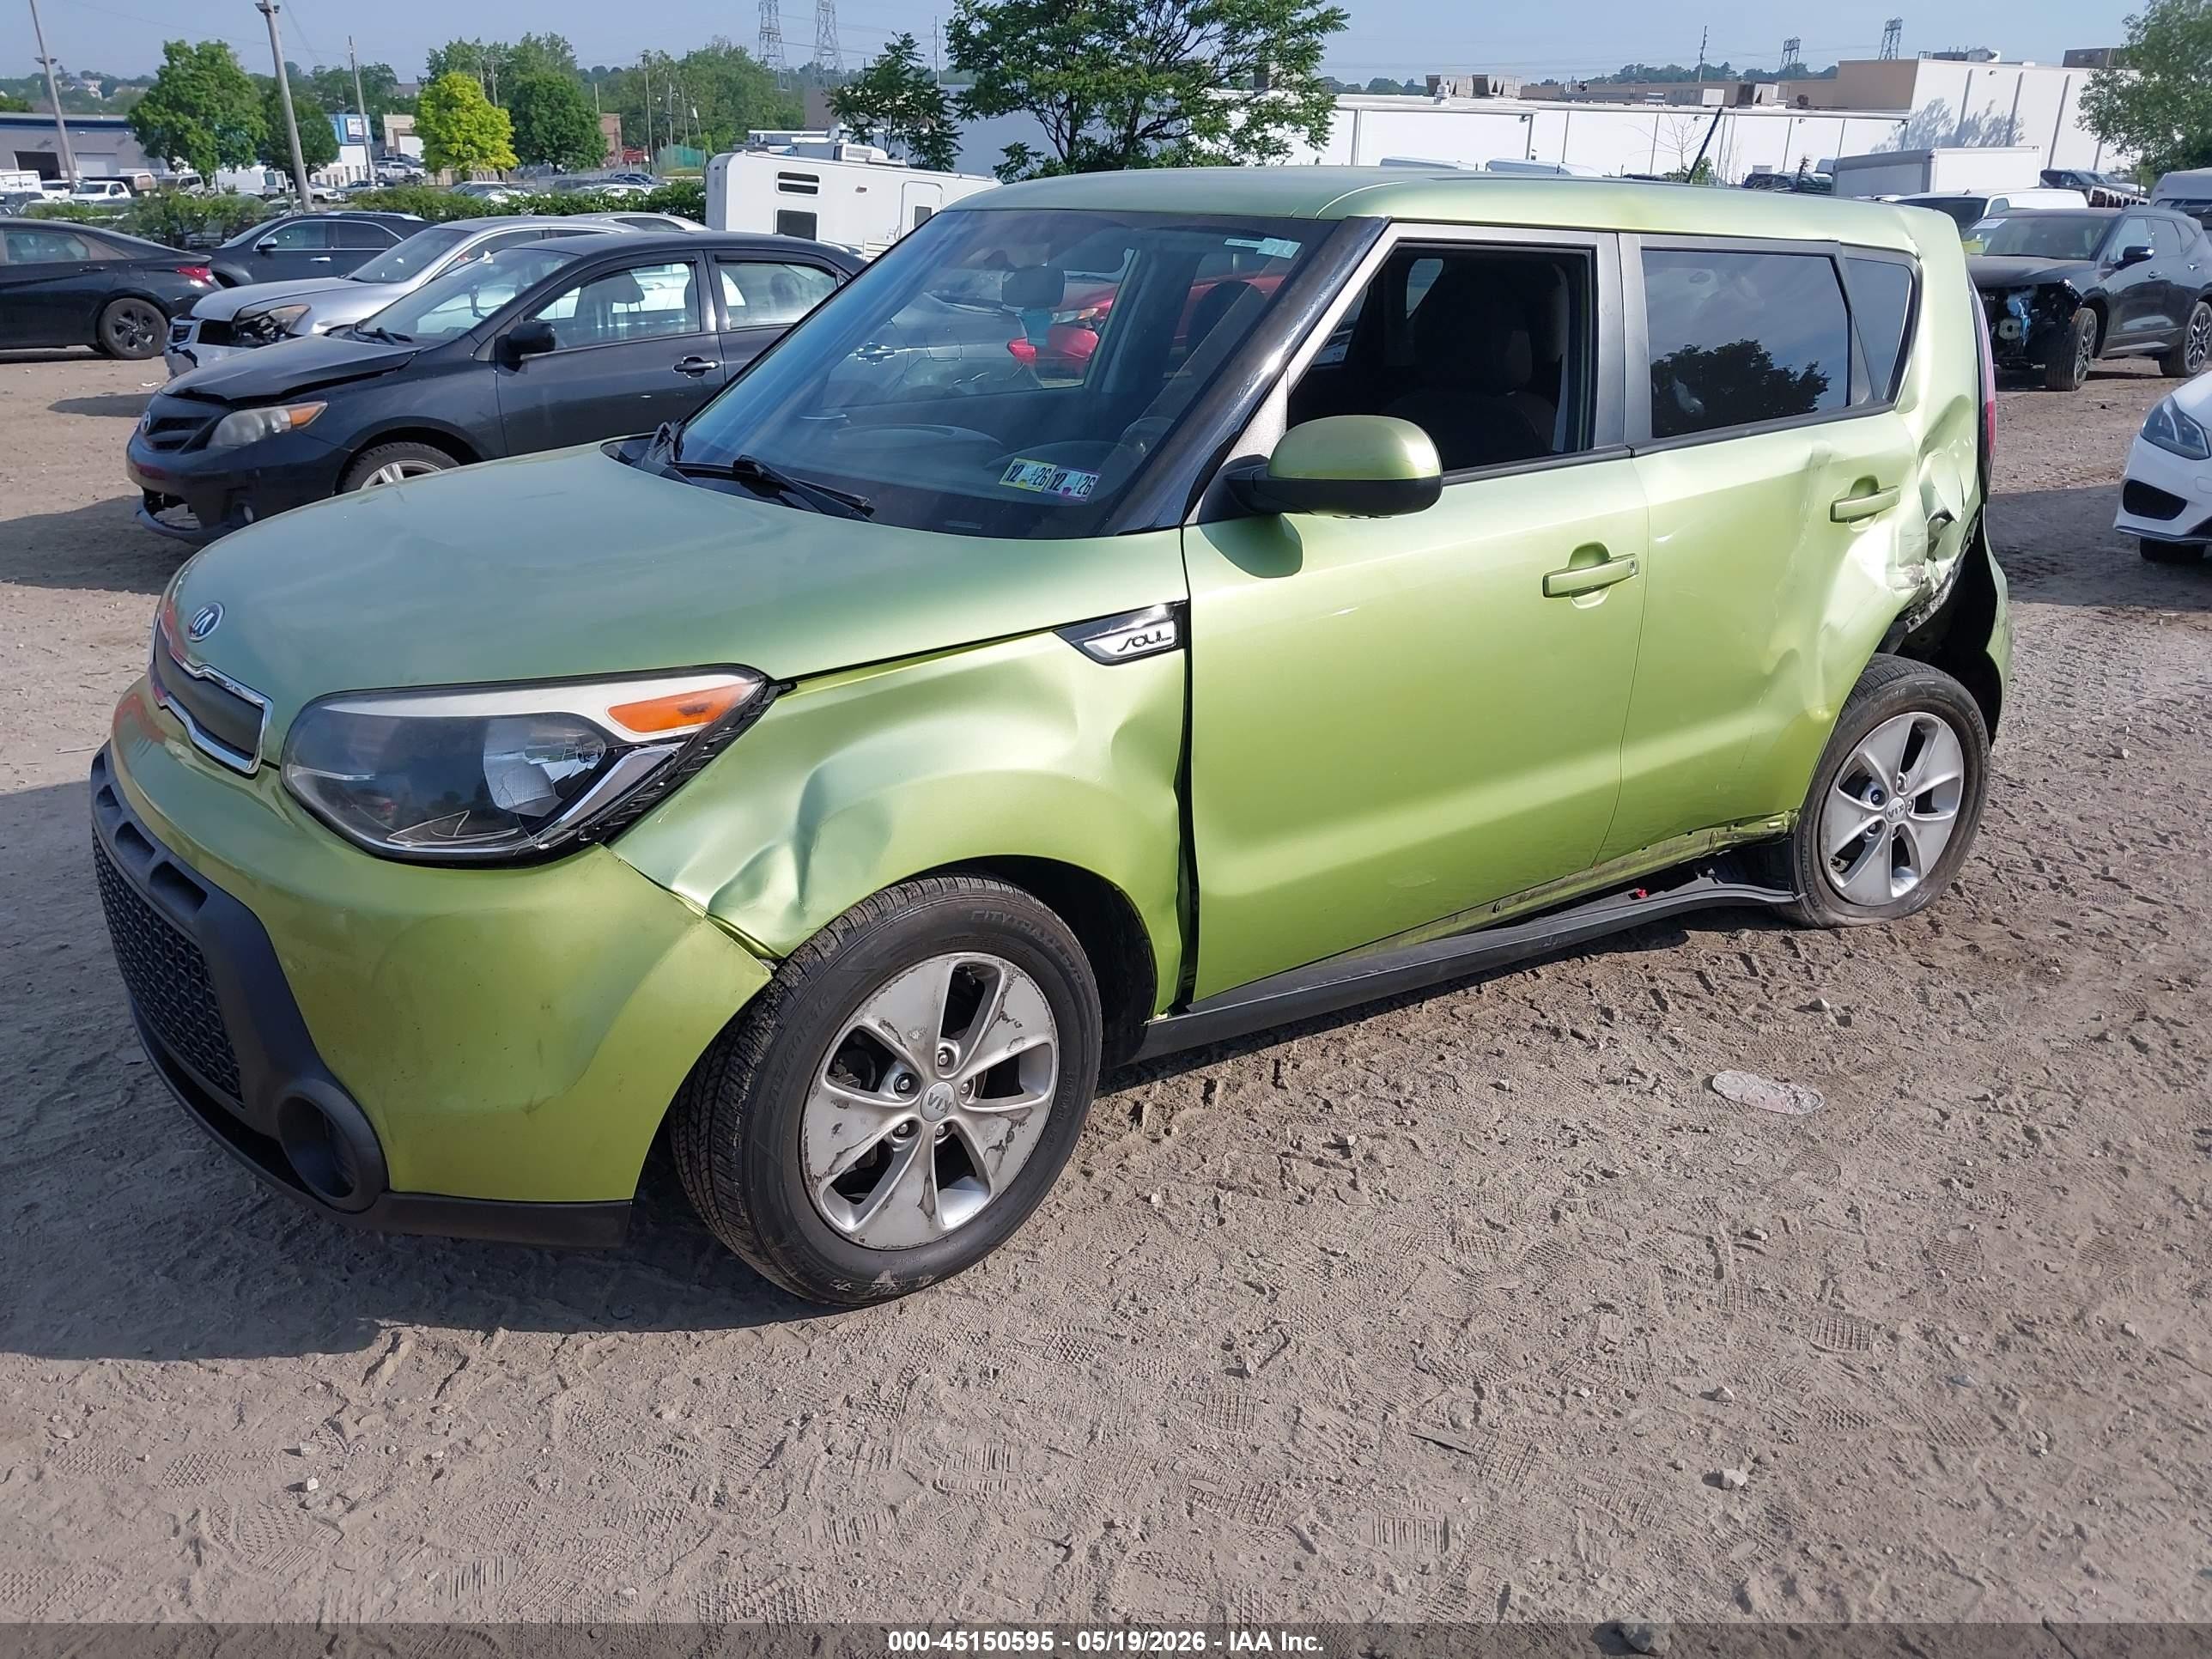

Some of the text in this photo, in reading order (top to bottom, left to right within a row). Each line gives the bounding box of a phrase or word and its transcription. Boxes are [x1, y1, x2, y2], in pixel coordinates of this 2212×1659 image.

[1006, 465, 1053, 486] 12 26
[1048, 472, 1097, 495] 12 26
[1116, 630, 1173, 653] SOUL
[1887, 803, 1905, 818] KIA
[927, 1091, 952, 1114] KIA
